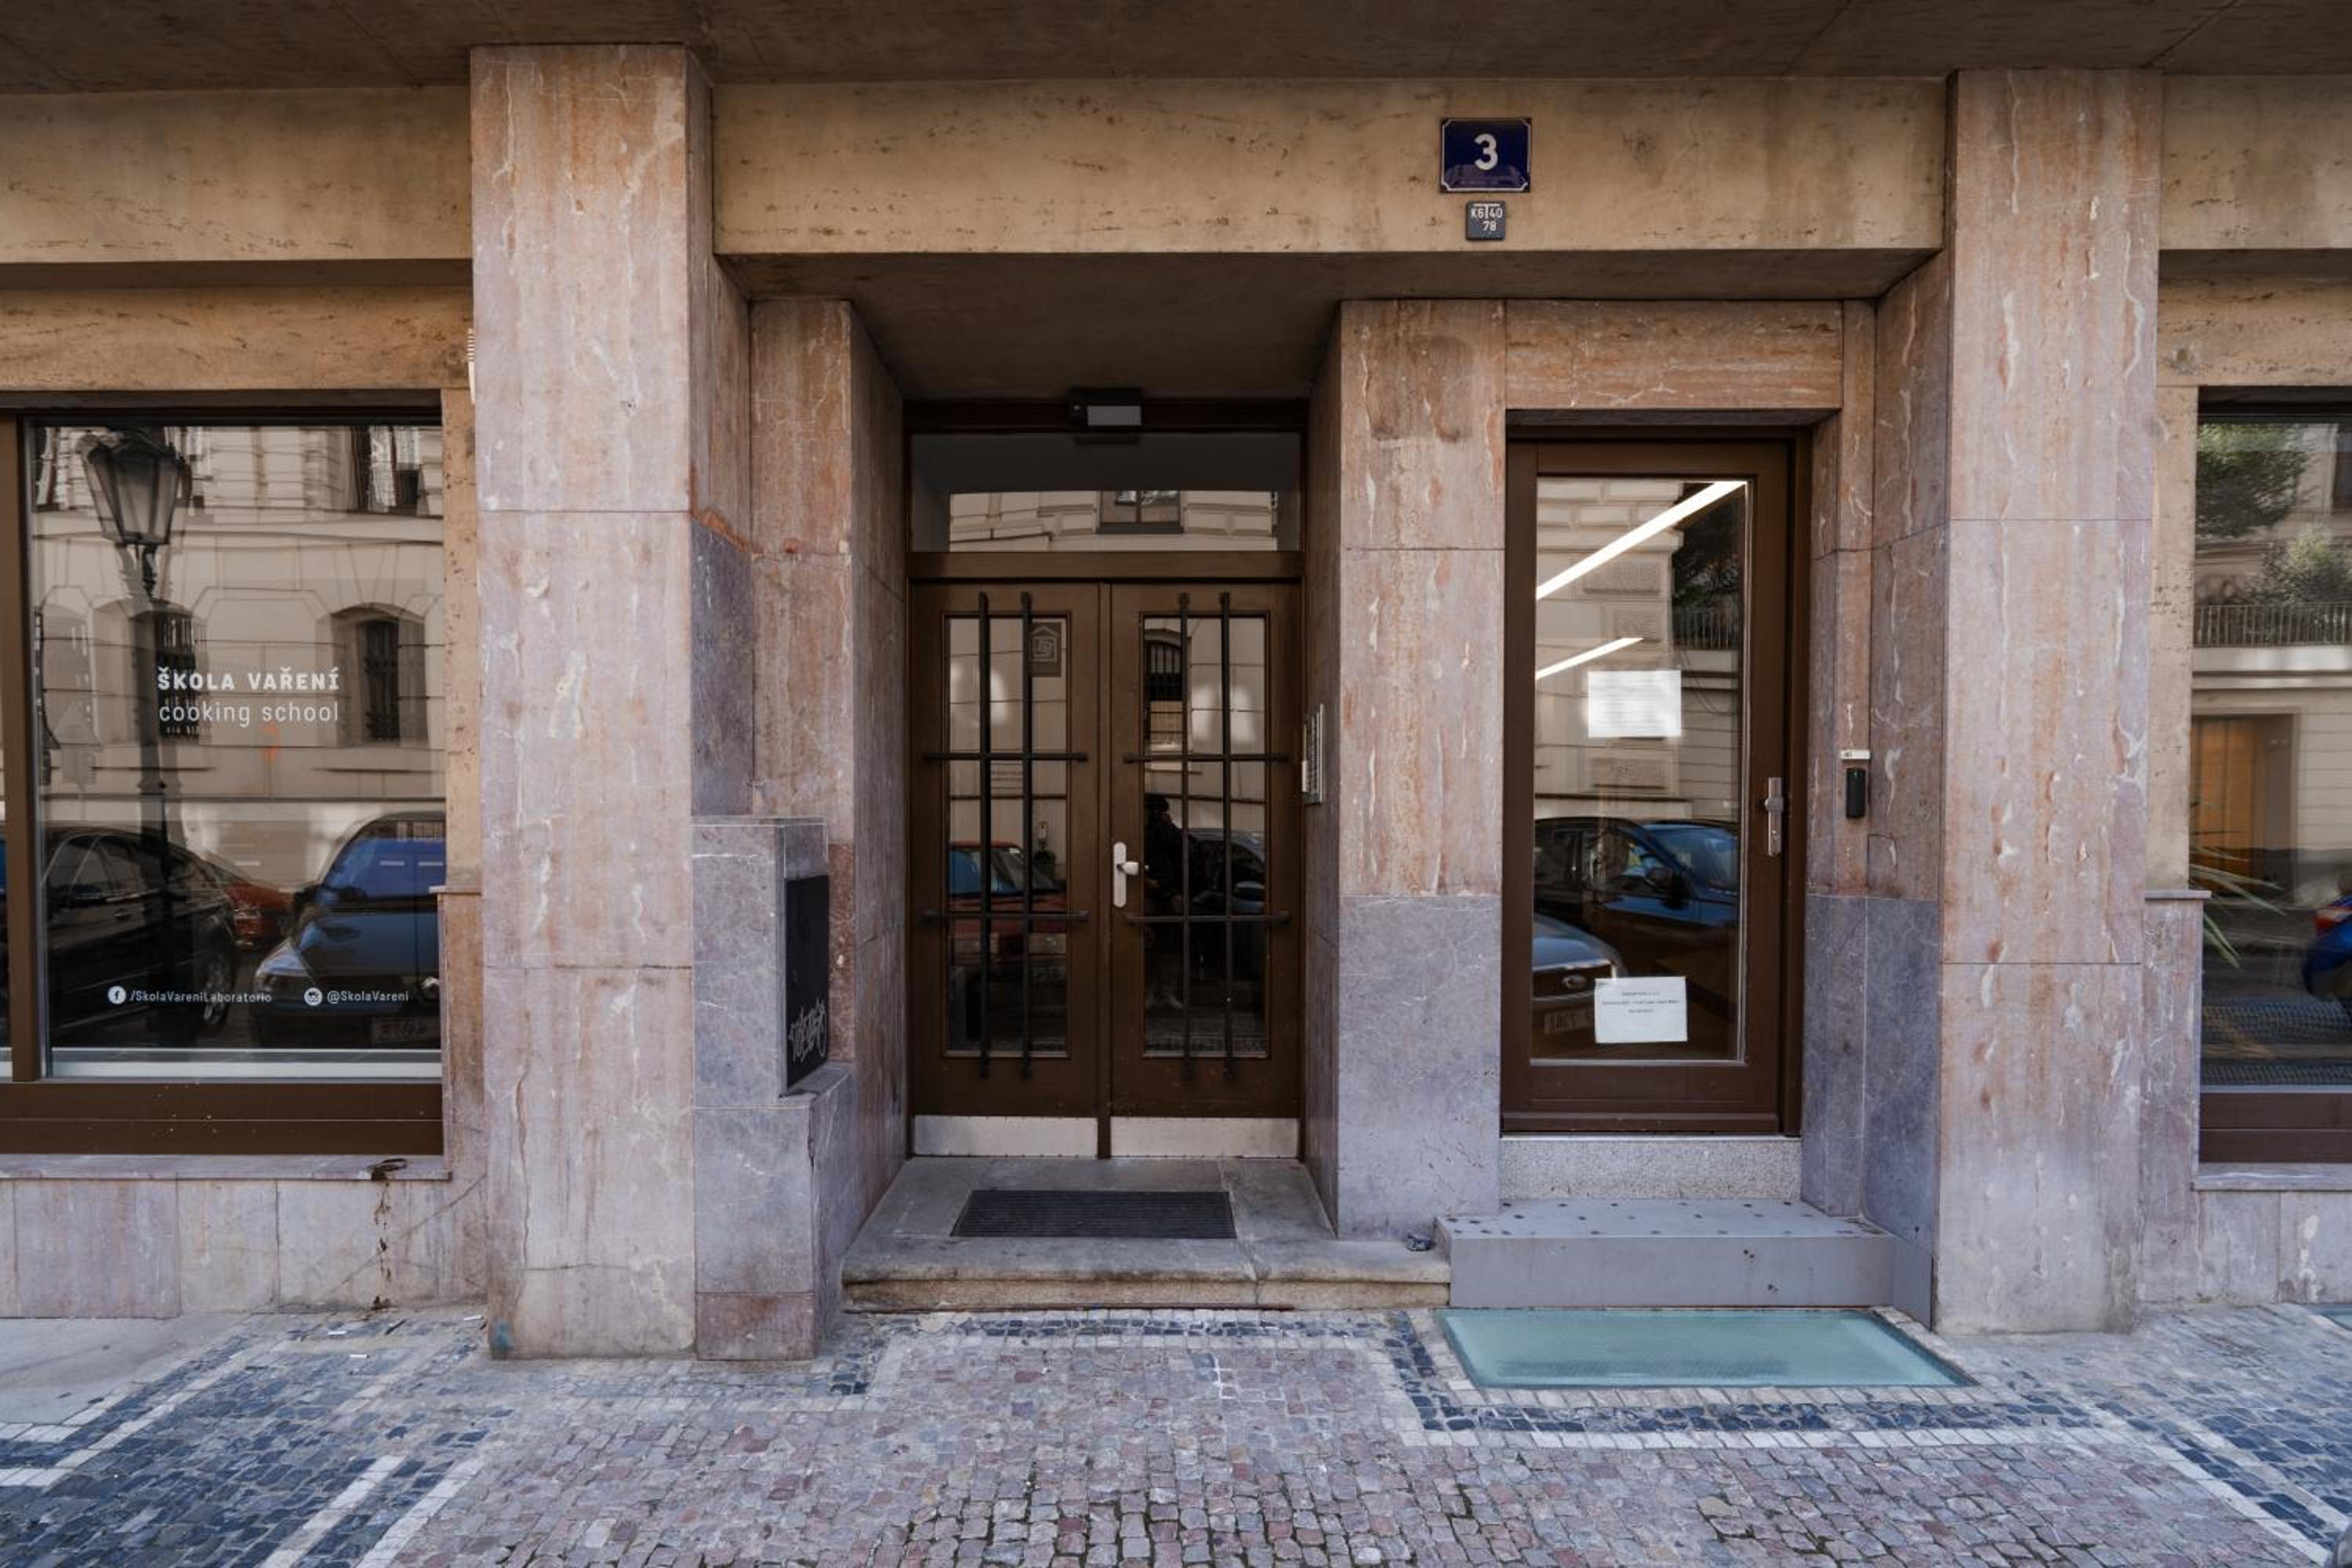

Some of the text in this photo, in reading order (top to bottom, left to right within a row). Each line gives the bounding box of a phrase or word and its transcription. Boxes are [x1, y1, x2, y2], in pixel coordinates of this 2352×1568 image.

[1475, 133, 1498, 170] 3
[158, 666, 339, 690] ŠKOLA VAŘENÍ
[159, 702, 338, 728] cooking school
[327, 990, 409, 1004] @SkolaVareni
